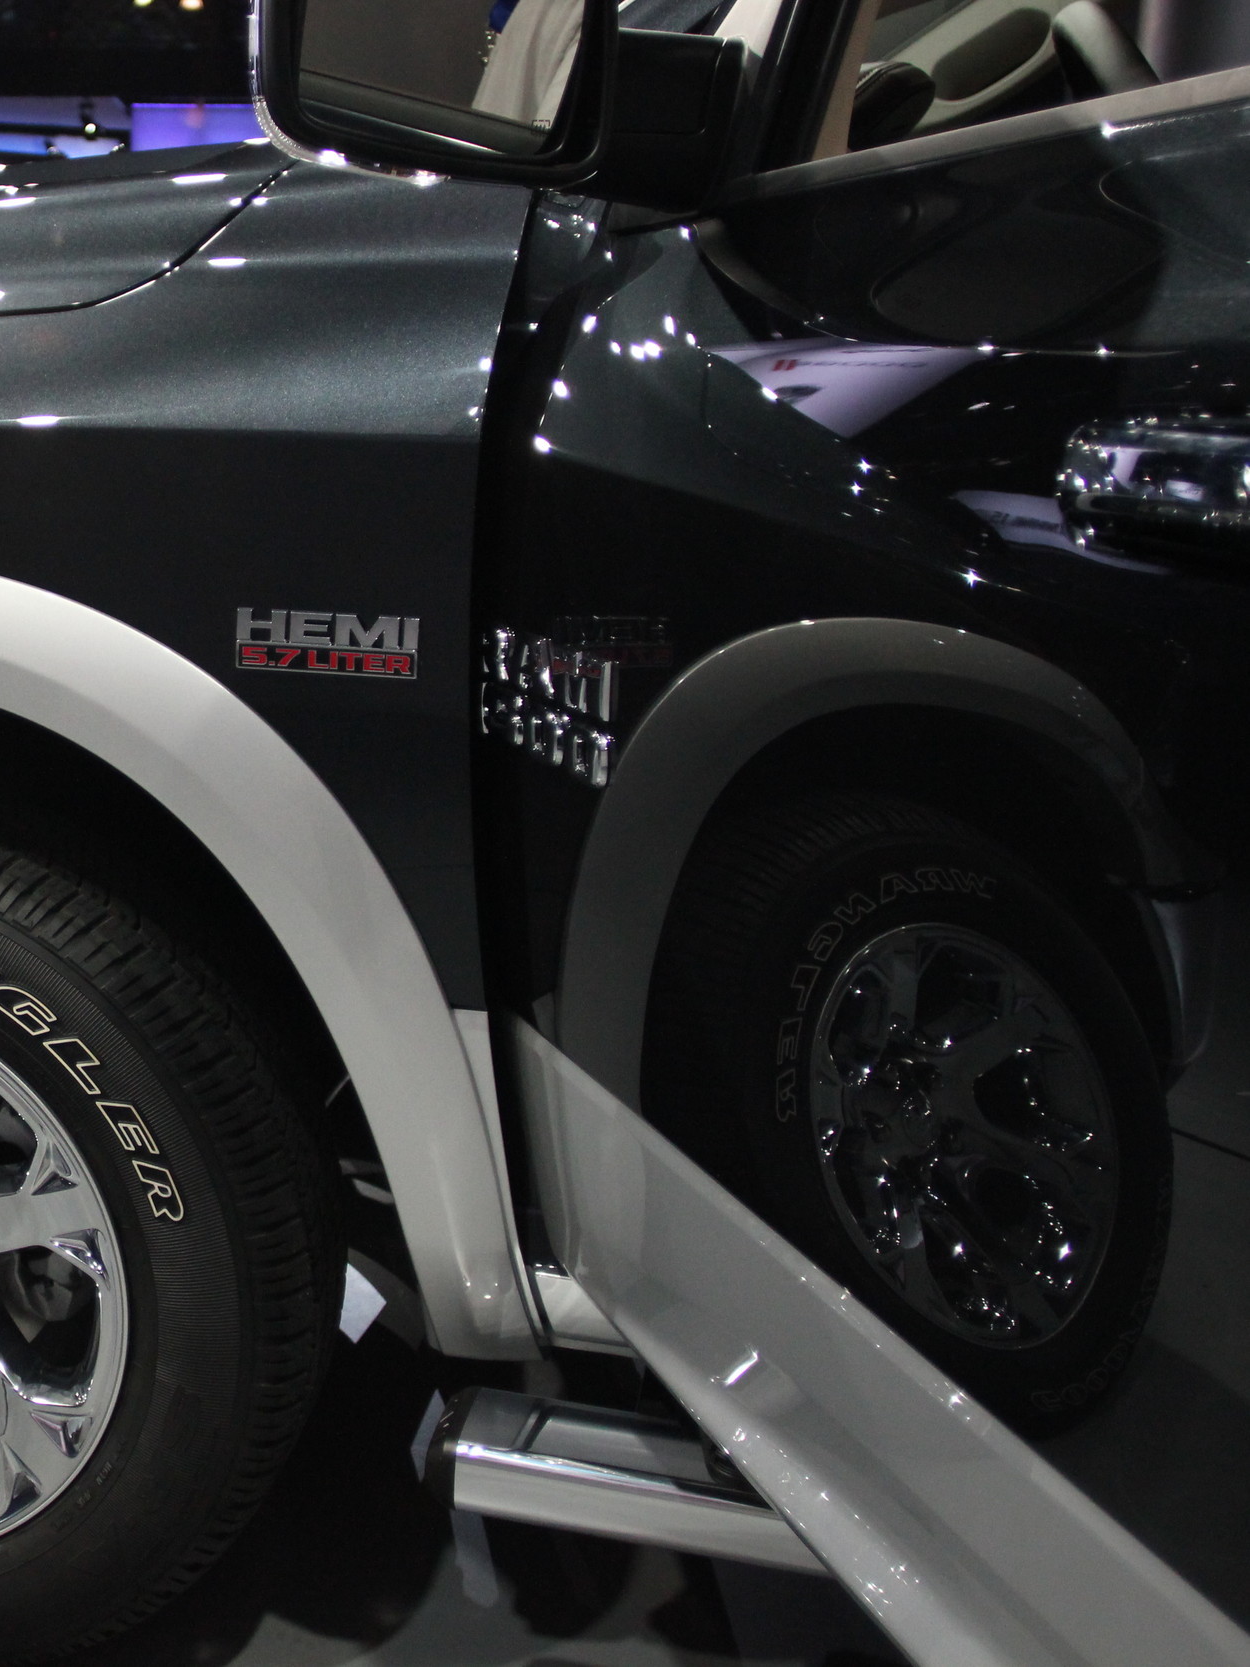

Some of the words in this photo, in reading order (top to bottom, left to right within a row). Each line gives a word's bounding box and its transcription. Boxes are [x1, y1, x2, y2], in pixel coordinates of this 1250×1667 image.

[236, 607, 420, 651] HEMI
[241, 646, 301, 667] 5.7
[307, 650, 412, 675] LITER
